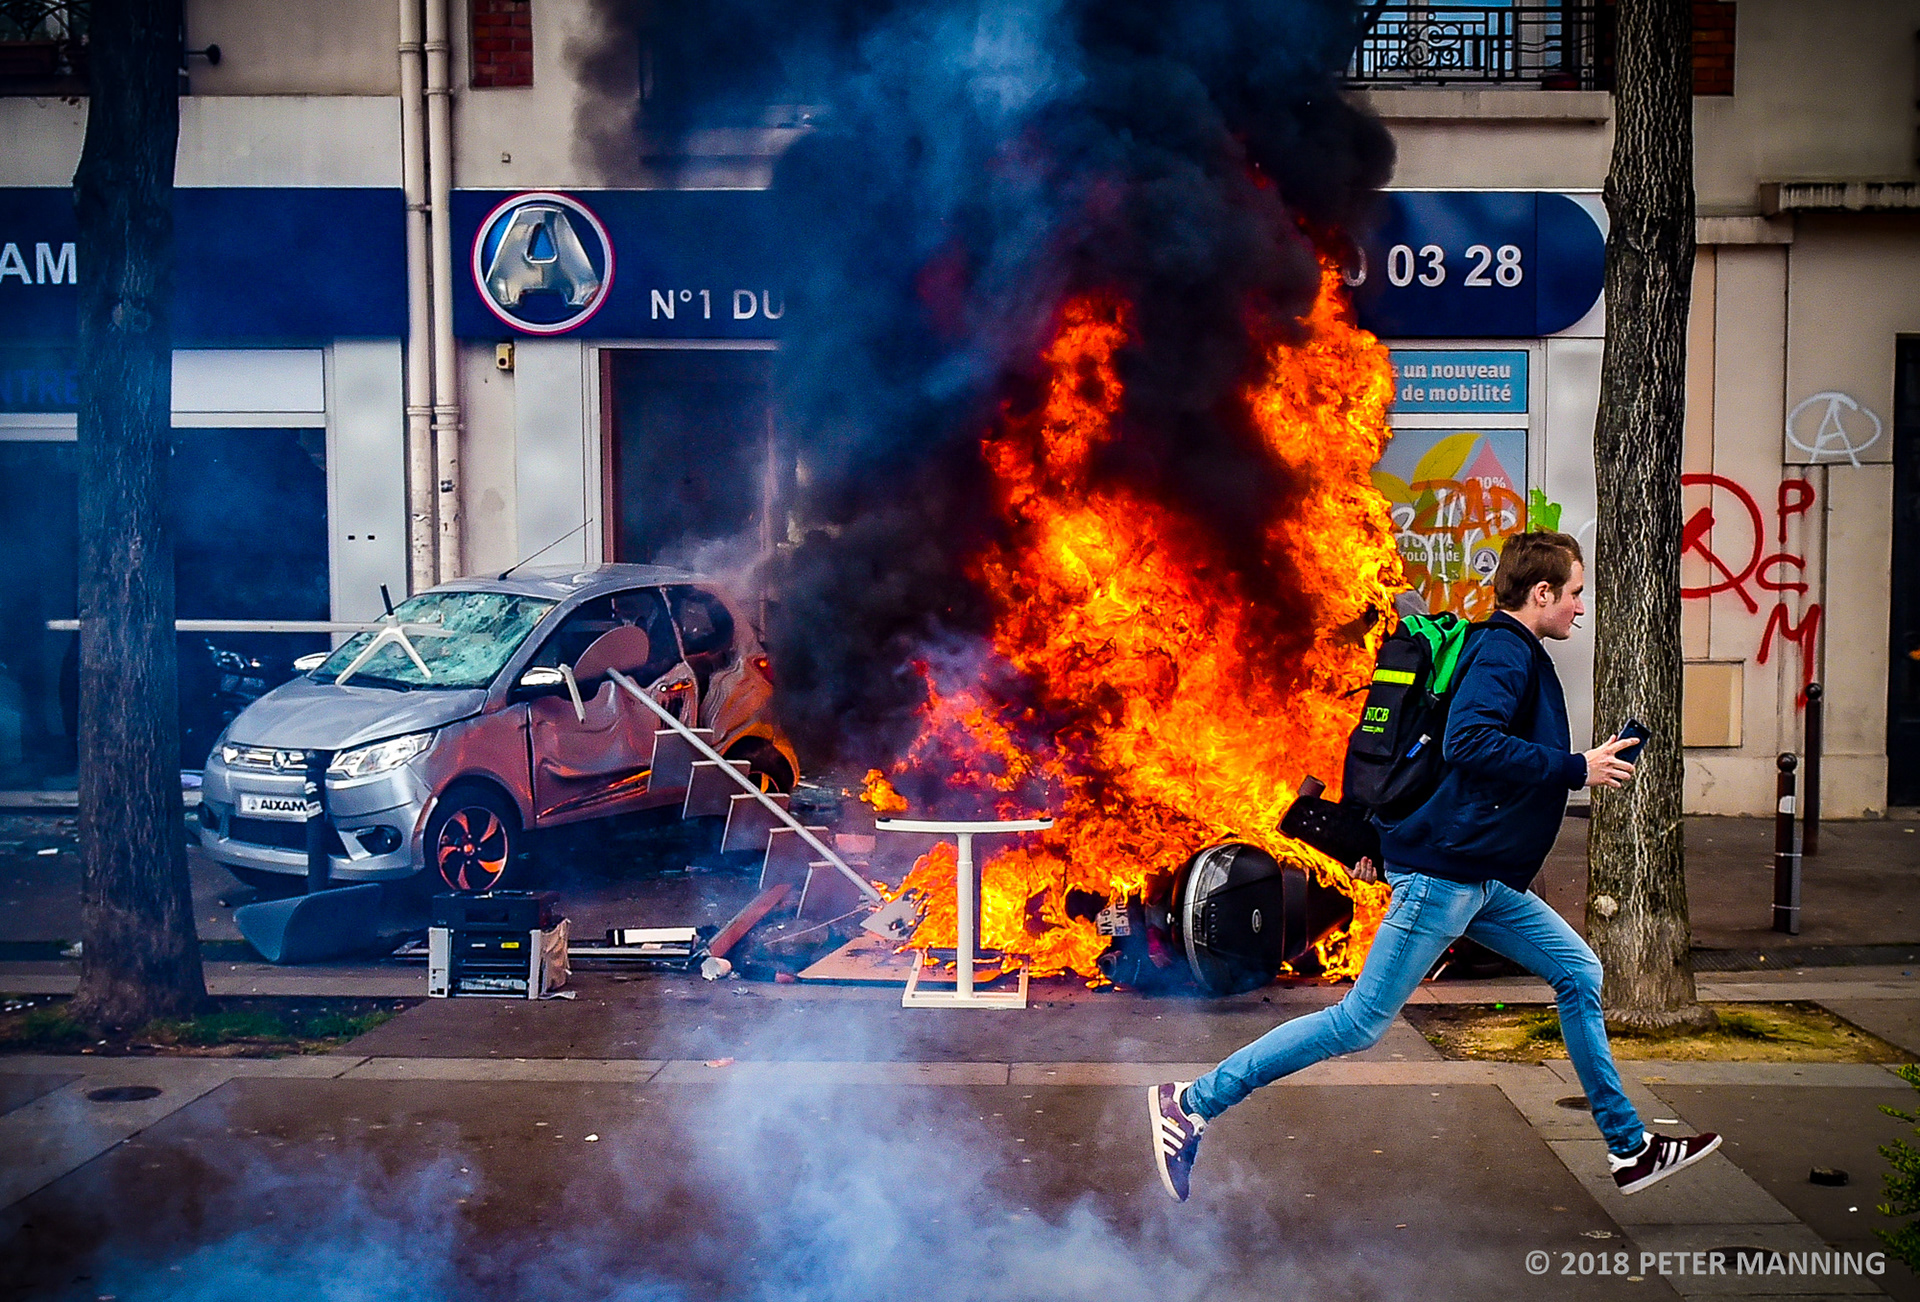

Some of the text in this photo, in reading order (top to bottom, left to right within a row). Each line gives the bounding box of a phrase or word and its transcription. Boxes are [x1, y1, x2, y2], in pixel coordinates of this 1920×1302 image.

[1387, 244, 1446, 287] 03
[1463, 244, 1523, 287] 28
[651, 289, 785, 320] N°1 DU
[1404, 365, 1427, 379] un
[1431, 365, 1511, 379] nouveau
[1401, 383, 1512, 402] de mobilité
[260, 799, 307, 812] AIXAM
